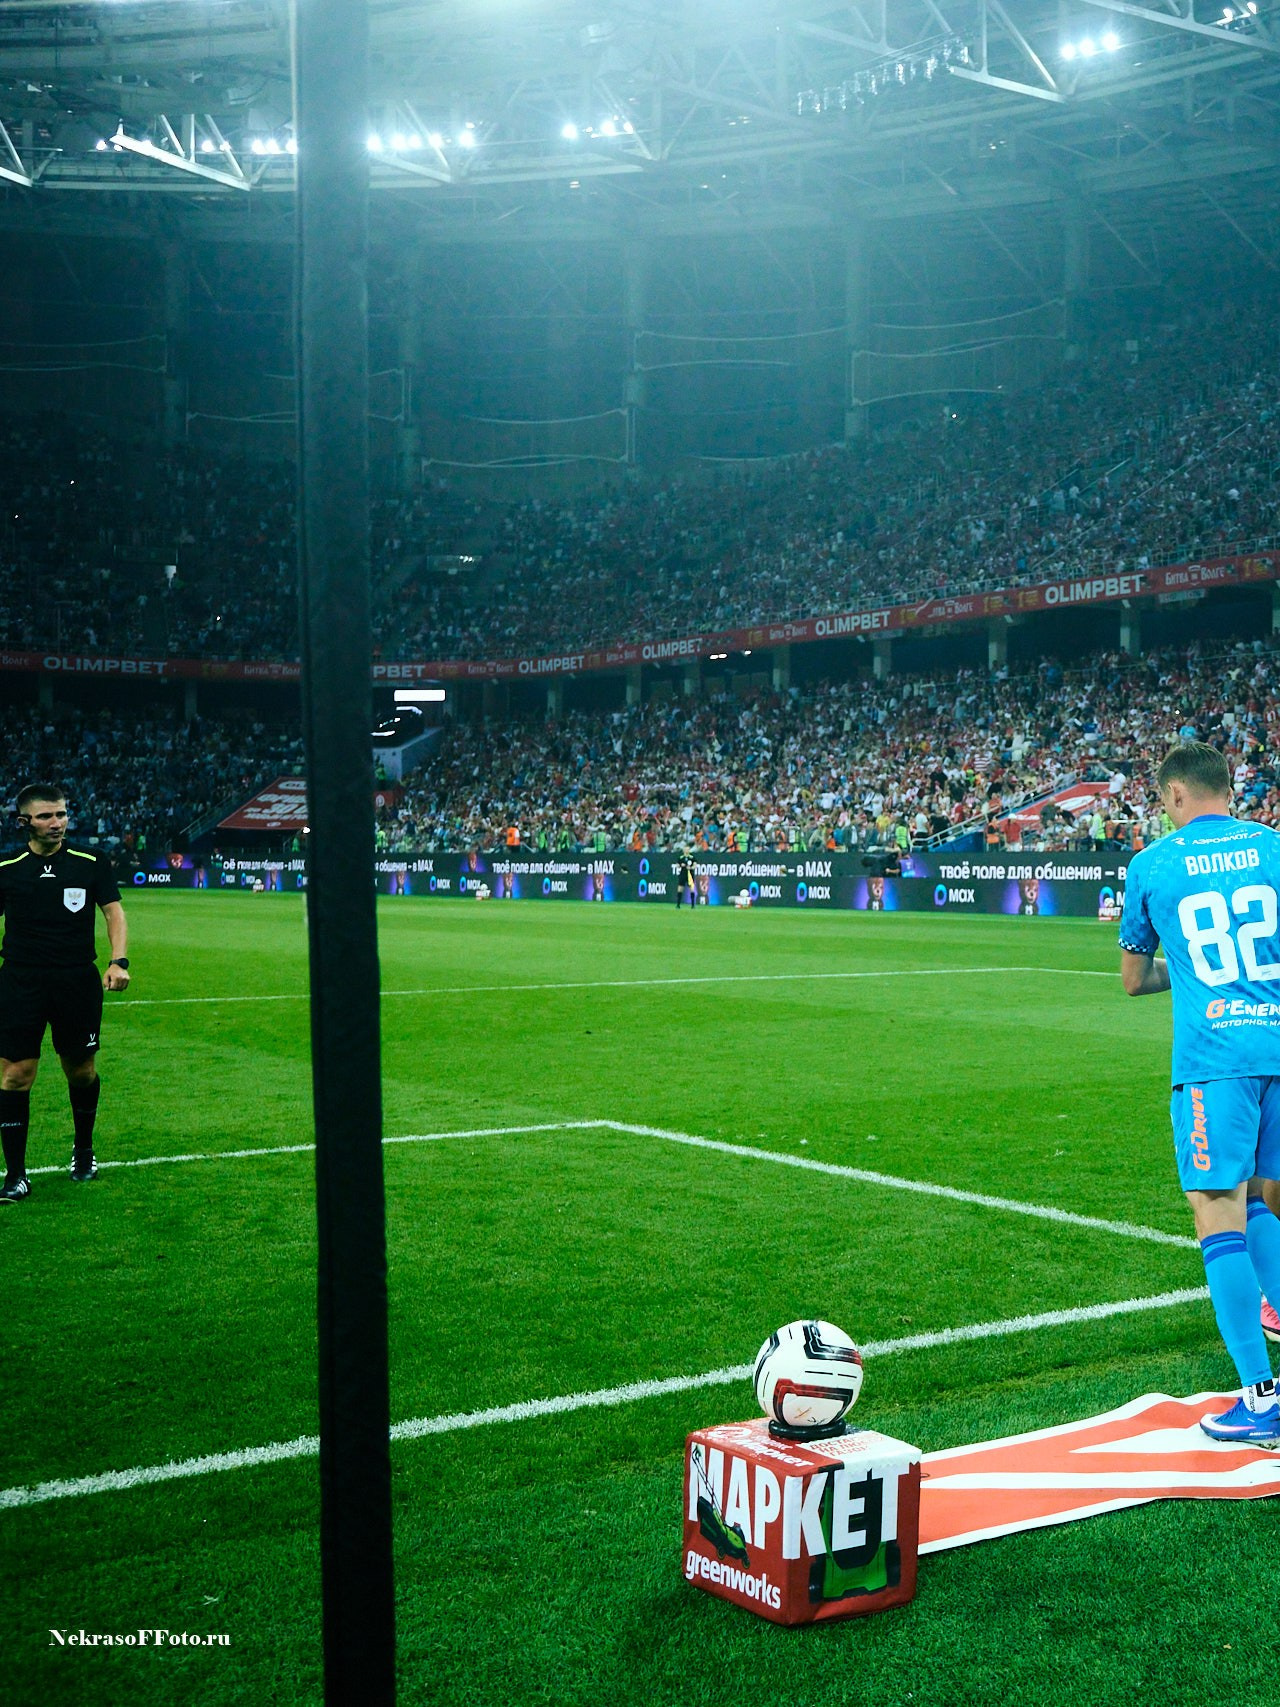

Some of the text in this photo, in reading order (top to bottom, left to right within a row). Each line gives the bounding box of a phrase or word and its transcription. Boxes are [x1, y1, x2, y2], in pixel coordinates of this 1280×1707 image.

[1045, 574, 1145, 604] OLIMPBET
[815, 611, 891, 637] OLIMPBET
[642, 638, 703, 660] OLIMPBET
[43, 656, 168, 675] OLIMPBET
[372, 664, 426, 679] PBET
[518, 655, 585, 674] OLIMPBET
[1192, 832, 1249, 845] АЭРОФЛОТ
[939, 861, 970, 880] твоё
[1007, 865, 1033, 880] для
[1034, 861, 1102, 881] общения
[1185, 848, 1260, 876] ВОЛКОВ
[687, 1442, 910, 1560] МАРКЕТ
[685, 1550, 782, 1610] greenworks
